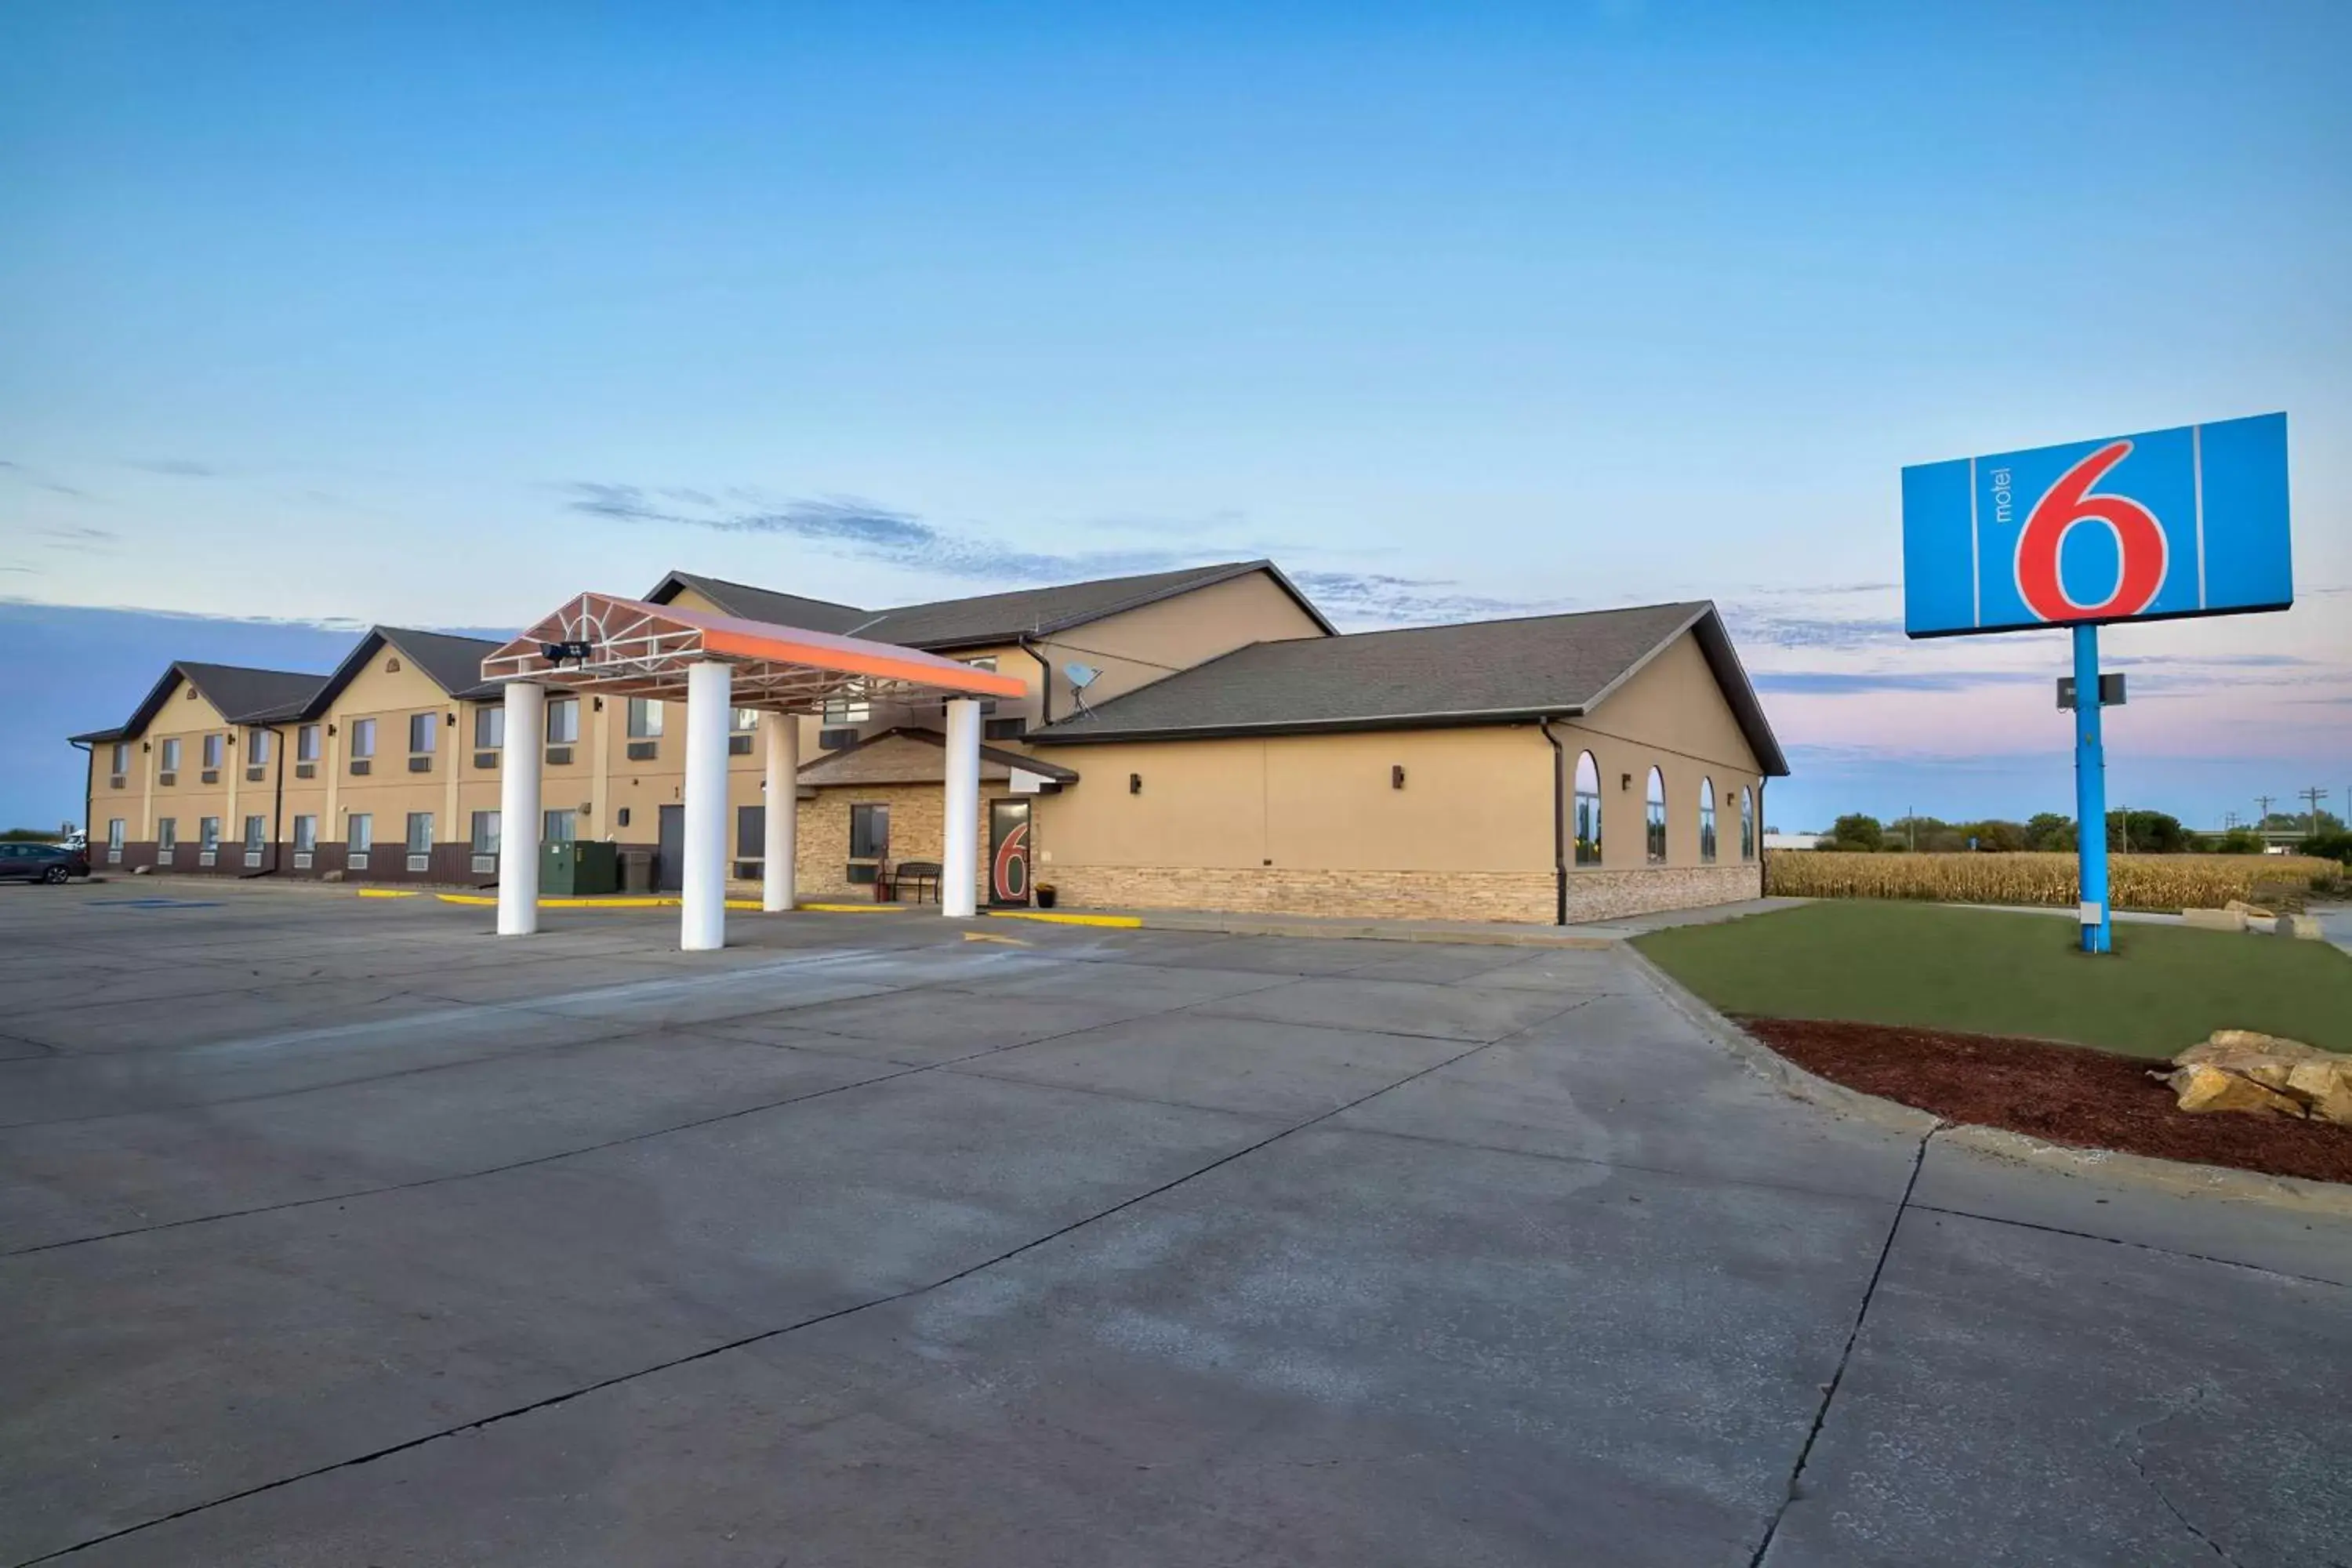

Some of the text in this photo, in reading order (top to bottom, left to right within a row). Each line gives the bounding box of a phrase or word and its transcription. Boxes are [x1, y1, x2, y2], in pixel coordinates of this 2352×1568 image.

[1990, 439, 2169, 622] motel 6
[994, 822, 1028, 901] 6
